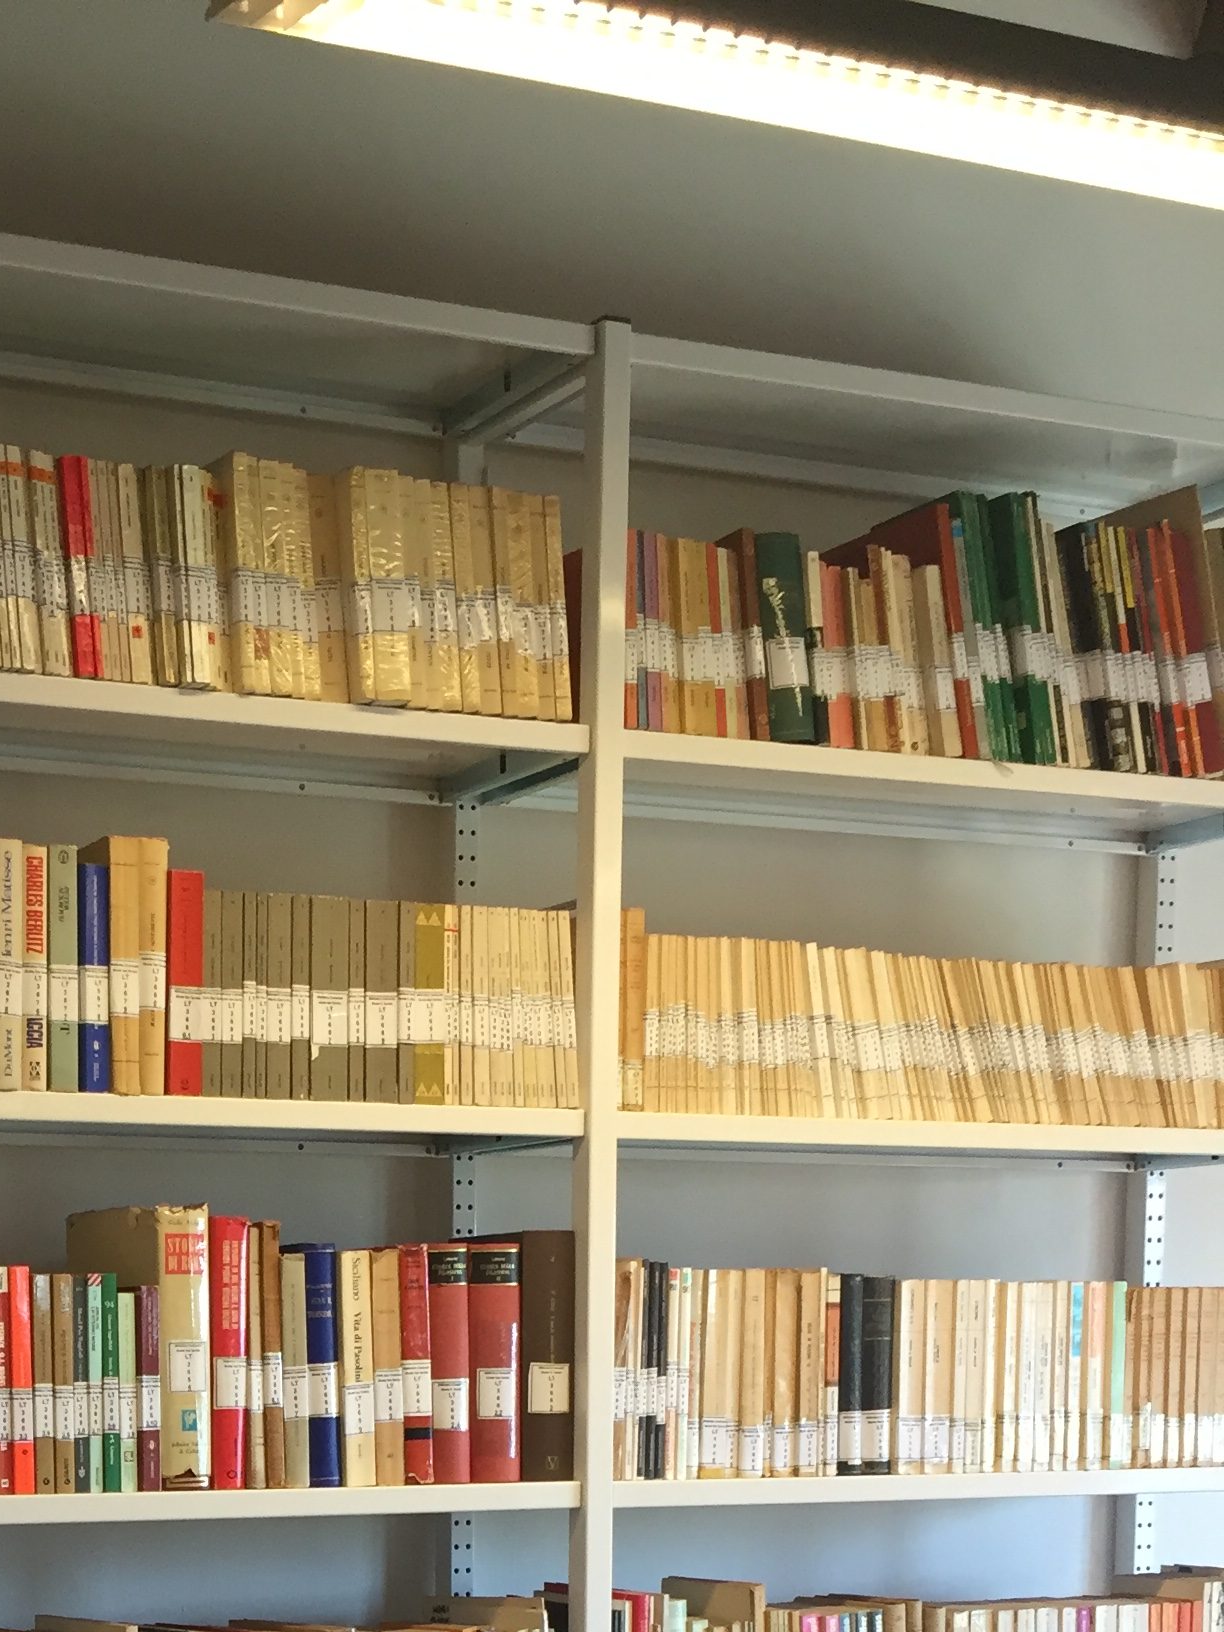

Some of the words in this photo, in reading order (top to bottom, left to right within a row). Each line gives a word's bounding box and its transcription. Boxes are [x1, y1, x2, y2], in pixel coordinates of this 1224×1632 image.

[2, 851, 13, 913] Matisse
[27, 856, 44, 908] CHARLES
[27, 910, 44, 954] BERLITZ
[3, 1028, 13, 1077] DuMont
[352, 1311, 361, 1331] Vita
[353, 1333, 362, 1343] di
[353, 1345, 363, 1383] Pasolini
